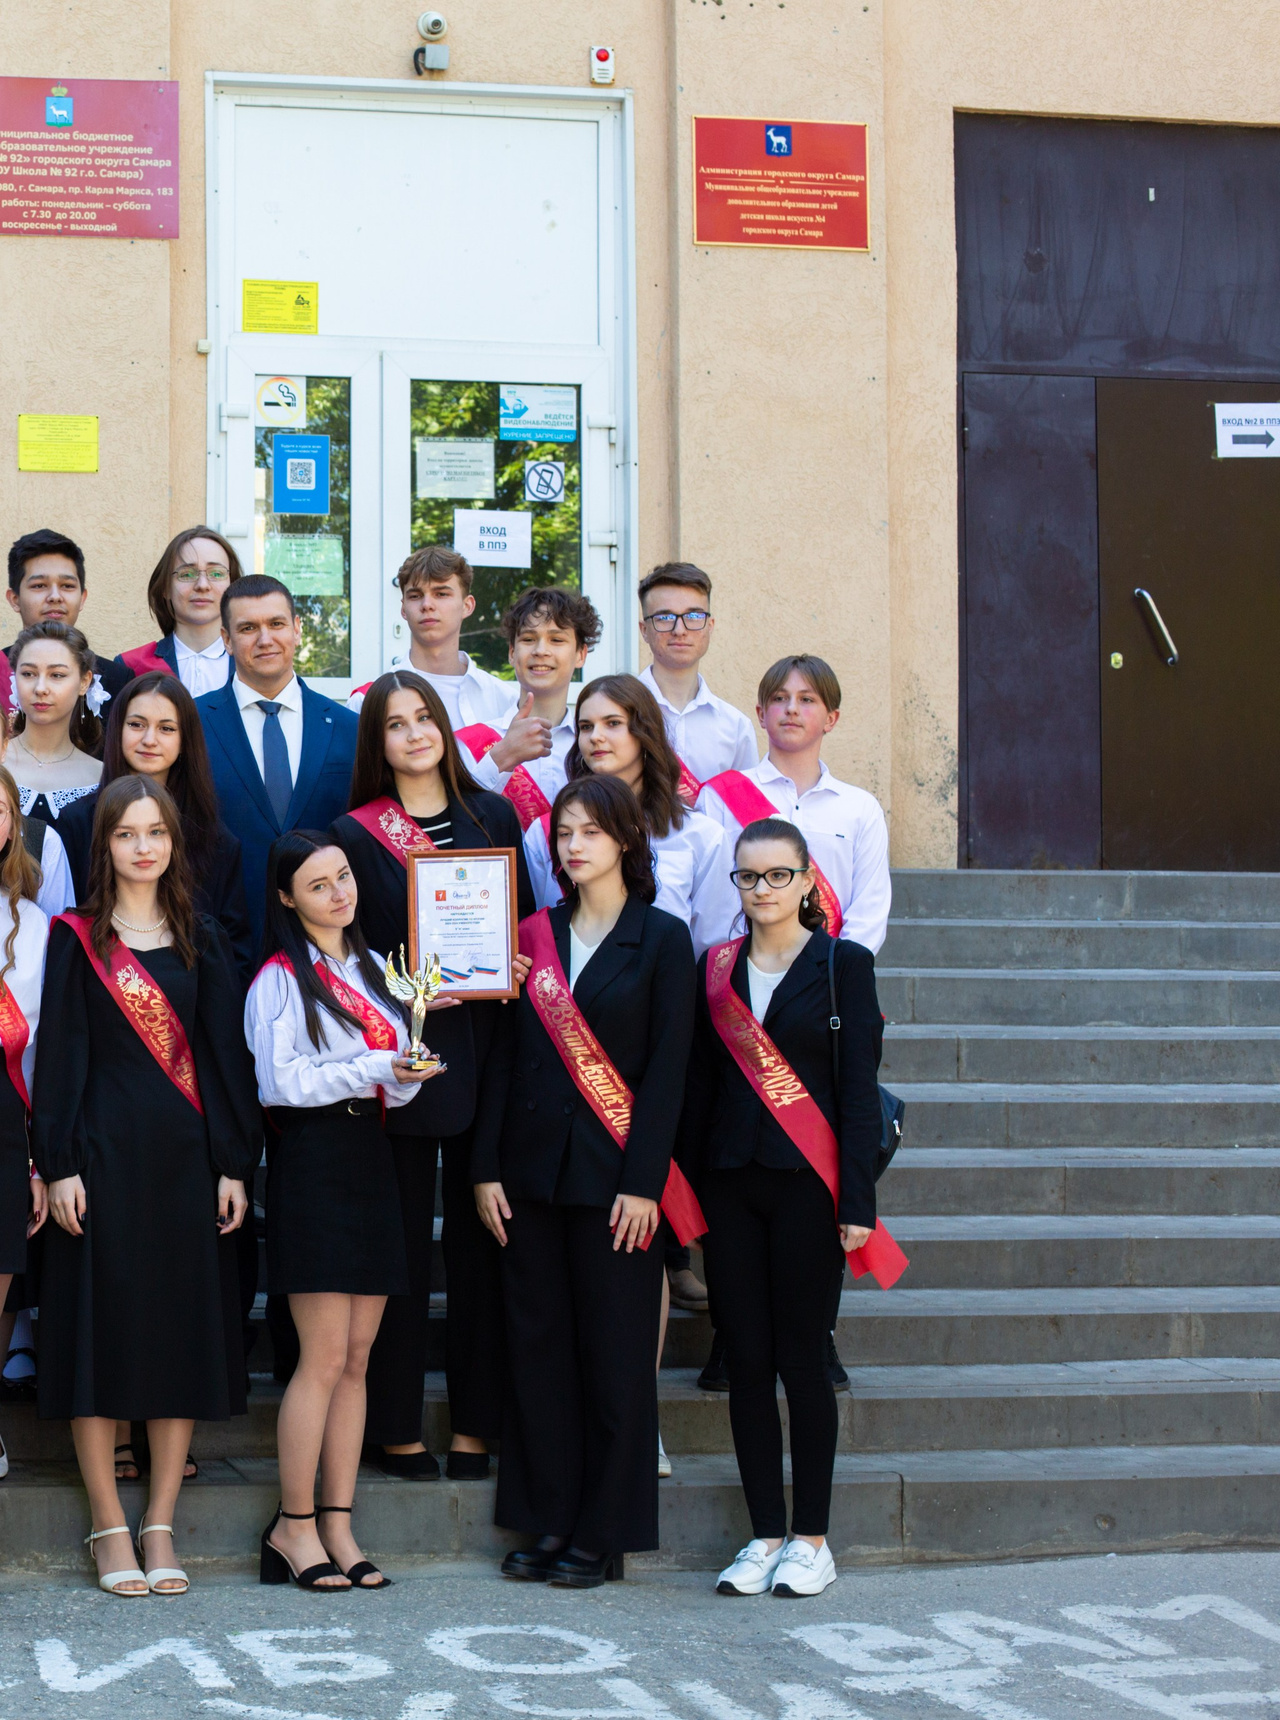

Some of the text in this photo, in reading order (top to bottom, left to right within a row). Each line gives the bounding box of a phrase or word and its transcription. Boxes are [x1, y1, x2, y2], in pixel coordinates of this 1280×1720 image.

[73, 132, 133, 142] бюджетное
[88, 145, 153, 155] учреждение
[10, 154, 30, 163] 92»
[33, 156, 92, 166] городского
[94, 158, 130, 167] округа
[132, 158, 172, 168] Самара
[13, 167, 47, 176] Школа
[50, 167, 62, 176] №
[65, 168, 77, 177] 92
[80, 170, 97, 178] г.о.
[99, 169, 143, 180] Самара)
[699, 166, 865, 182] Администрация городского округа Самара
[28, 184, 66, 194] Самара,
[69, 187, 83, 195] пр.
[85, 185, 114, 196] Карла
[116, 186, 154, 197] Маркса,
[156, 187, 173, 195] 183
[705, 183, 859, 198] Муниципальное общеобразовательное учреждение
[2, 198, 40, 208] работы:
[42, 200, 103, 209] понедельник
[113, 201, 151, 211] суббота
[727, 199, 838, 210] дополнительного образования детей
[31, 210, 51, 218] 7.30
[55, 212, 68, 220] до
[70, 211, 97, 220] 20.00
[787, 215, 814, 224] искусств
[815, 215, 825, 223] №4
[2, 221, 62, 230] воскресенье
[70, 222, 117, 232] выходной
[742, 228, 823, 238] городского округа Самара
[1222, 418, 1243, 426] ВХОД
[480, 526, 506, 537] ВХОД
[479, 541, 507, 550] В ППЭ
[544, 997, 632, 1142] Выпускник 202
[755, 1064, 809, 1109] 2024
